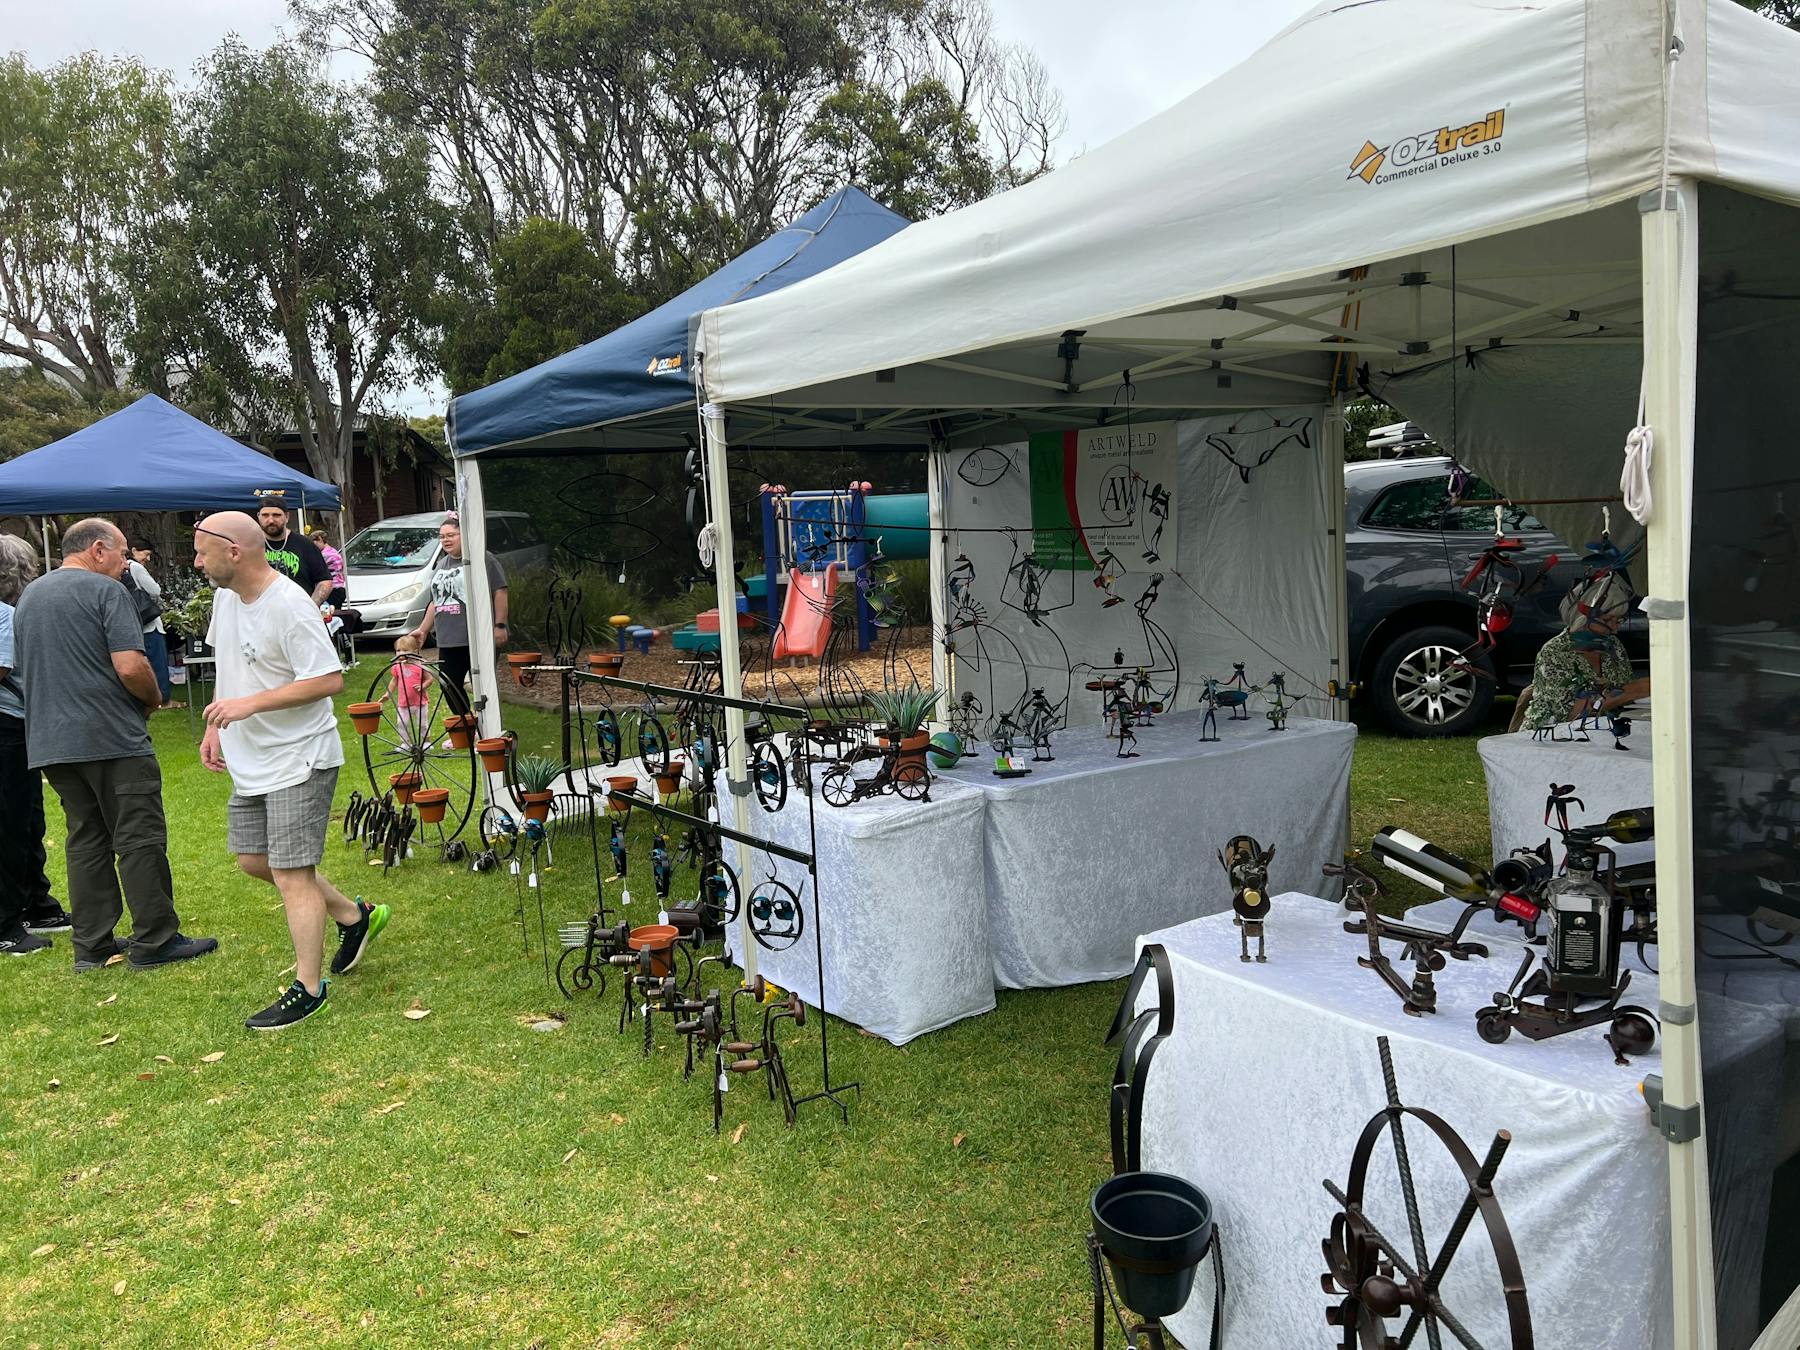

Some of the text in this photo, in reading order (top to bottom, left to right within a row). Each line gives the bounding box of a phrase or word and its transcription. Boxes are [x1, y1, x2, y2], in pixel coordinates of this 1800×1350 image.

[1375, 142, 1502, 185] Commercial Deluxe 3.0
[1088, 432, 1157, 452] ARTWELD
